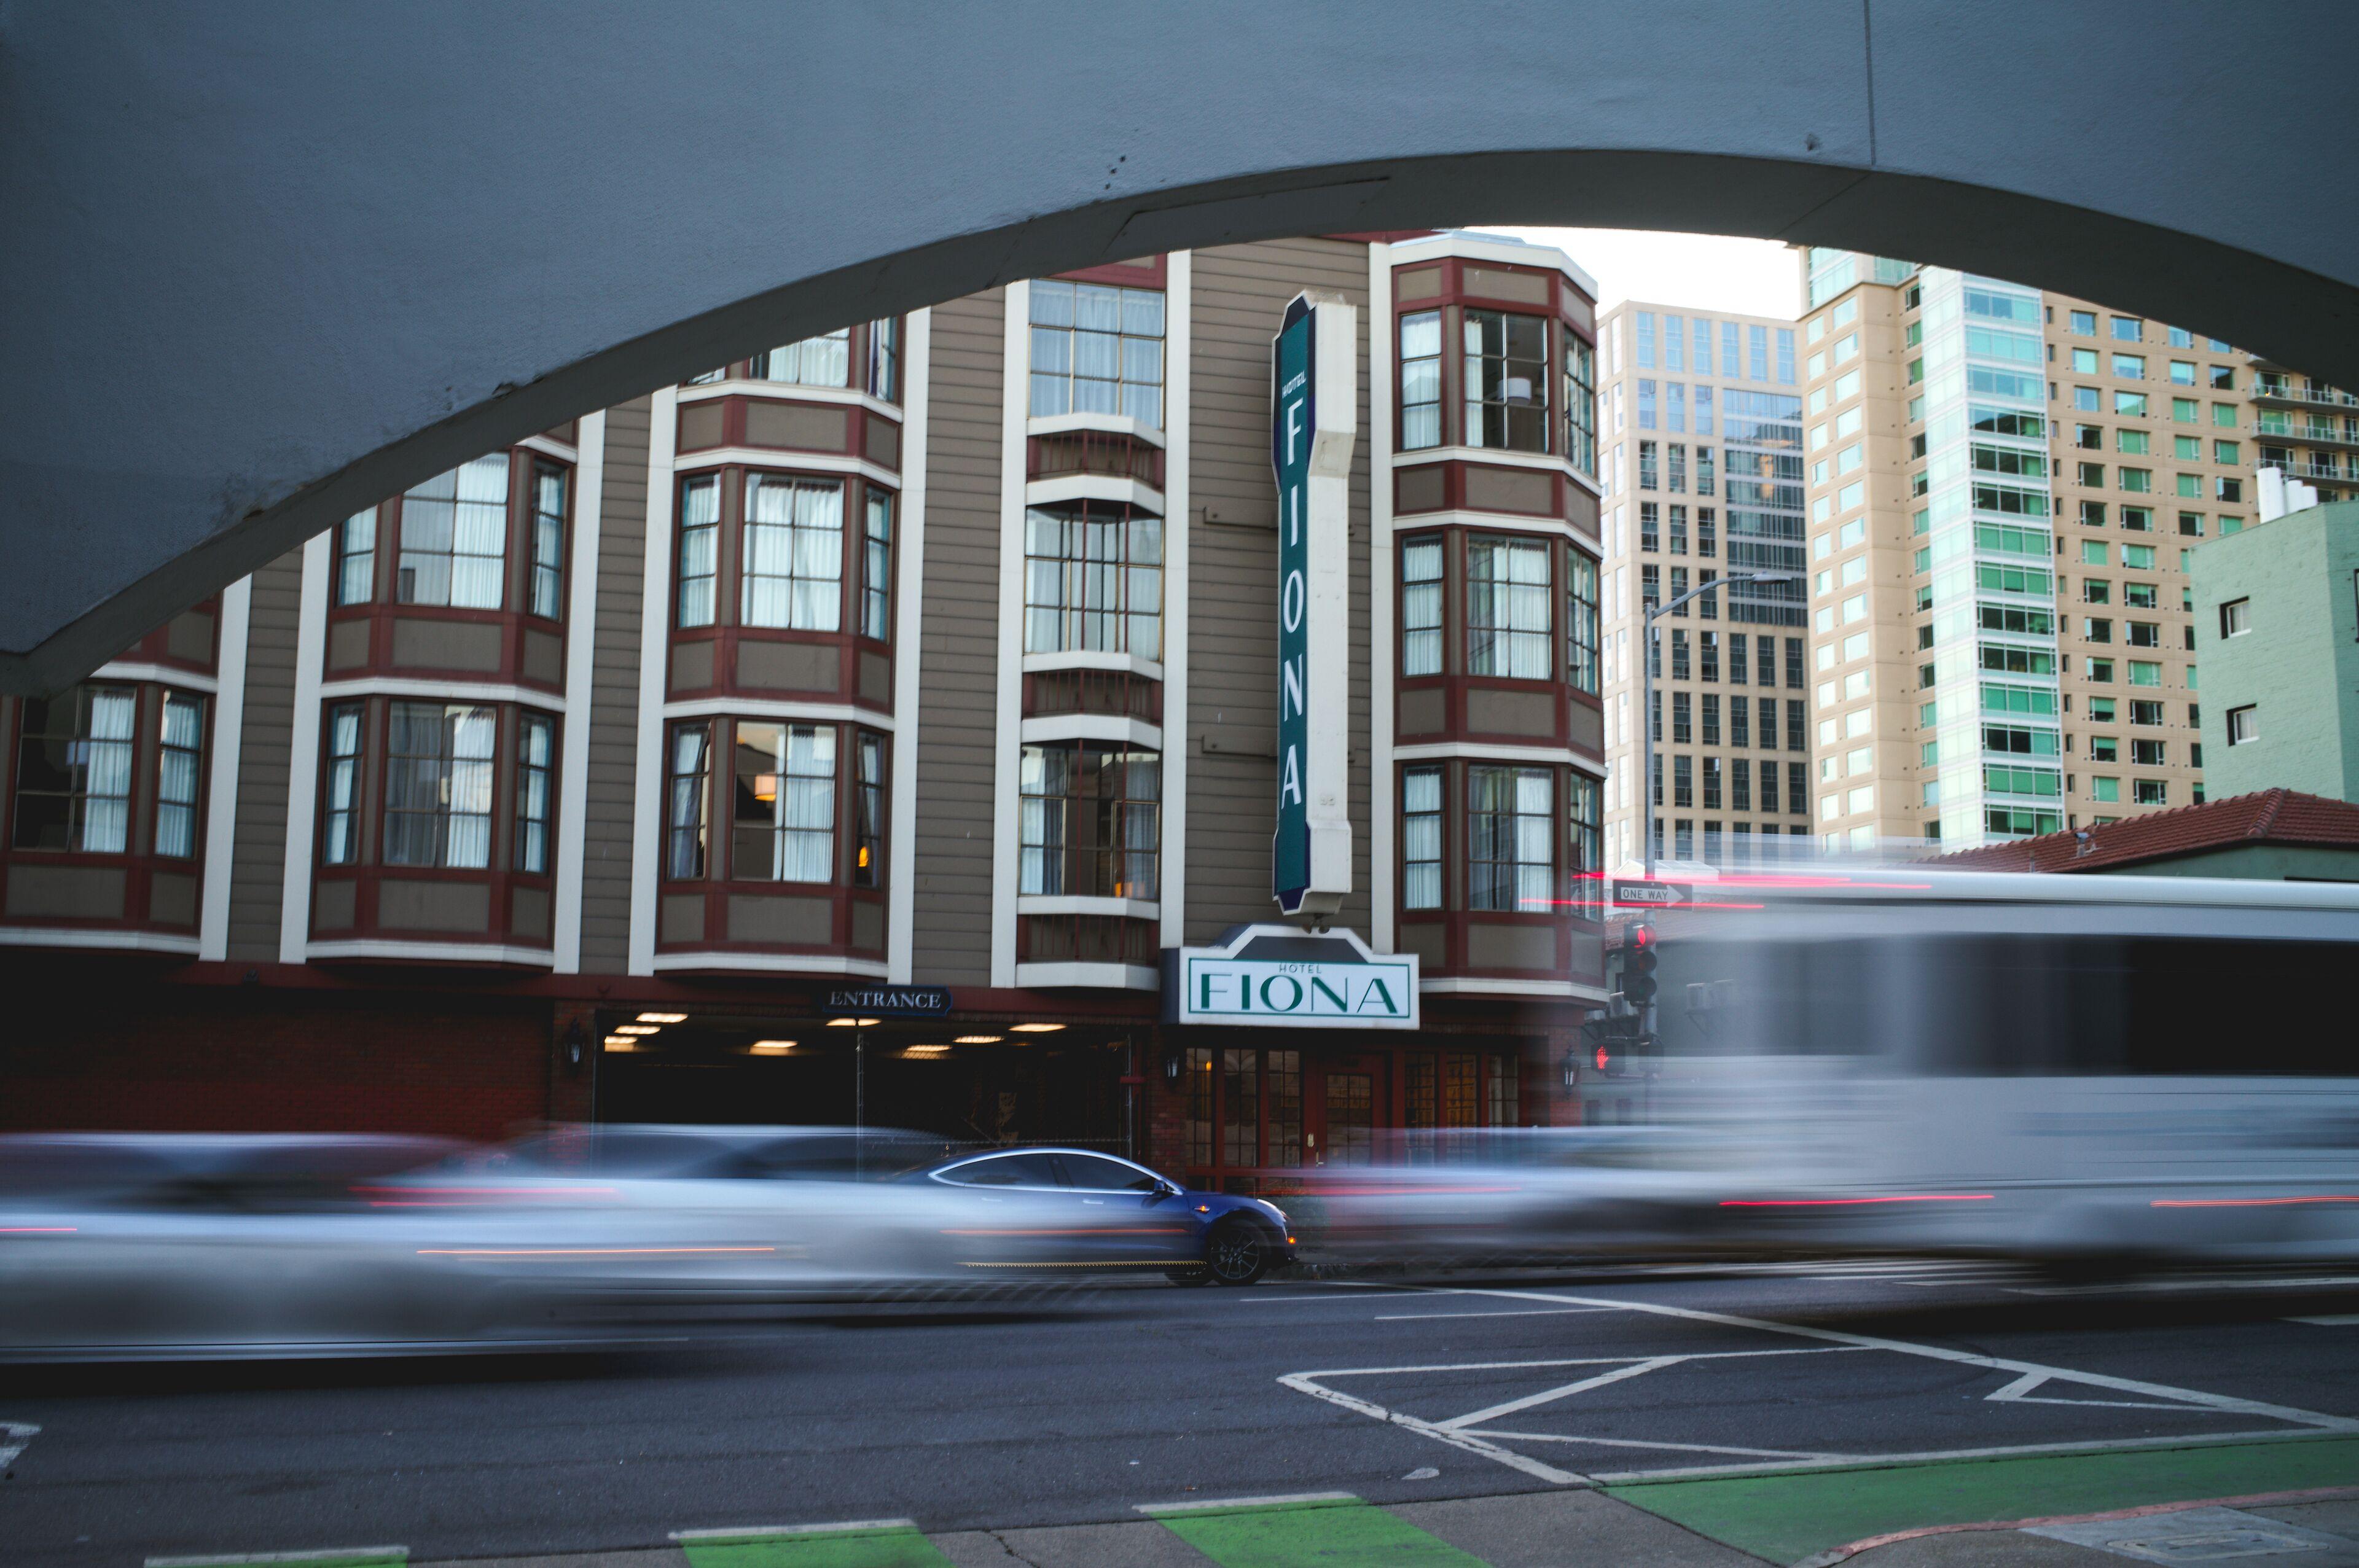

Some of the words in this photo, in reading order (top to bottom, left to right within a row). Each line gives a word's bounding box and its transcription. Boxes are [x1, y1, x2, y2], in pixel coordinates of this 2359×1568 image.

[1281, 370, 1307, 399] HOTEL
[1281, 397, 1304, 810] FIONA
[1623, 889, 1643, 899] ONE
[1648, 890, 1668, 900] WAY
[1279, 962, 1322, 974] HOTEL
[829, 991, 941, 1009] ENTRANCE
[1200, 973, 1398, 1014] FIONA
